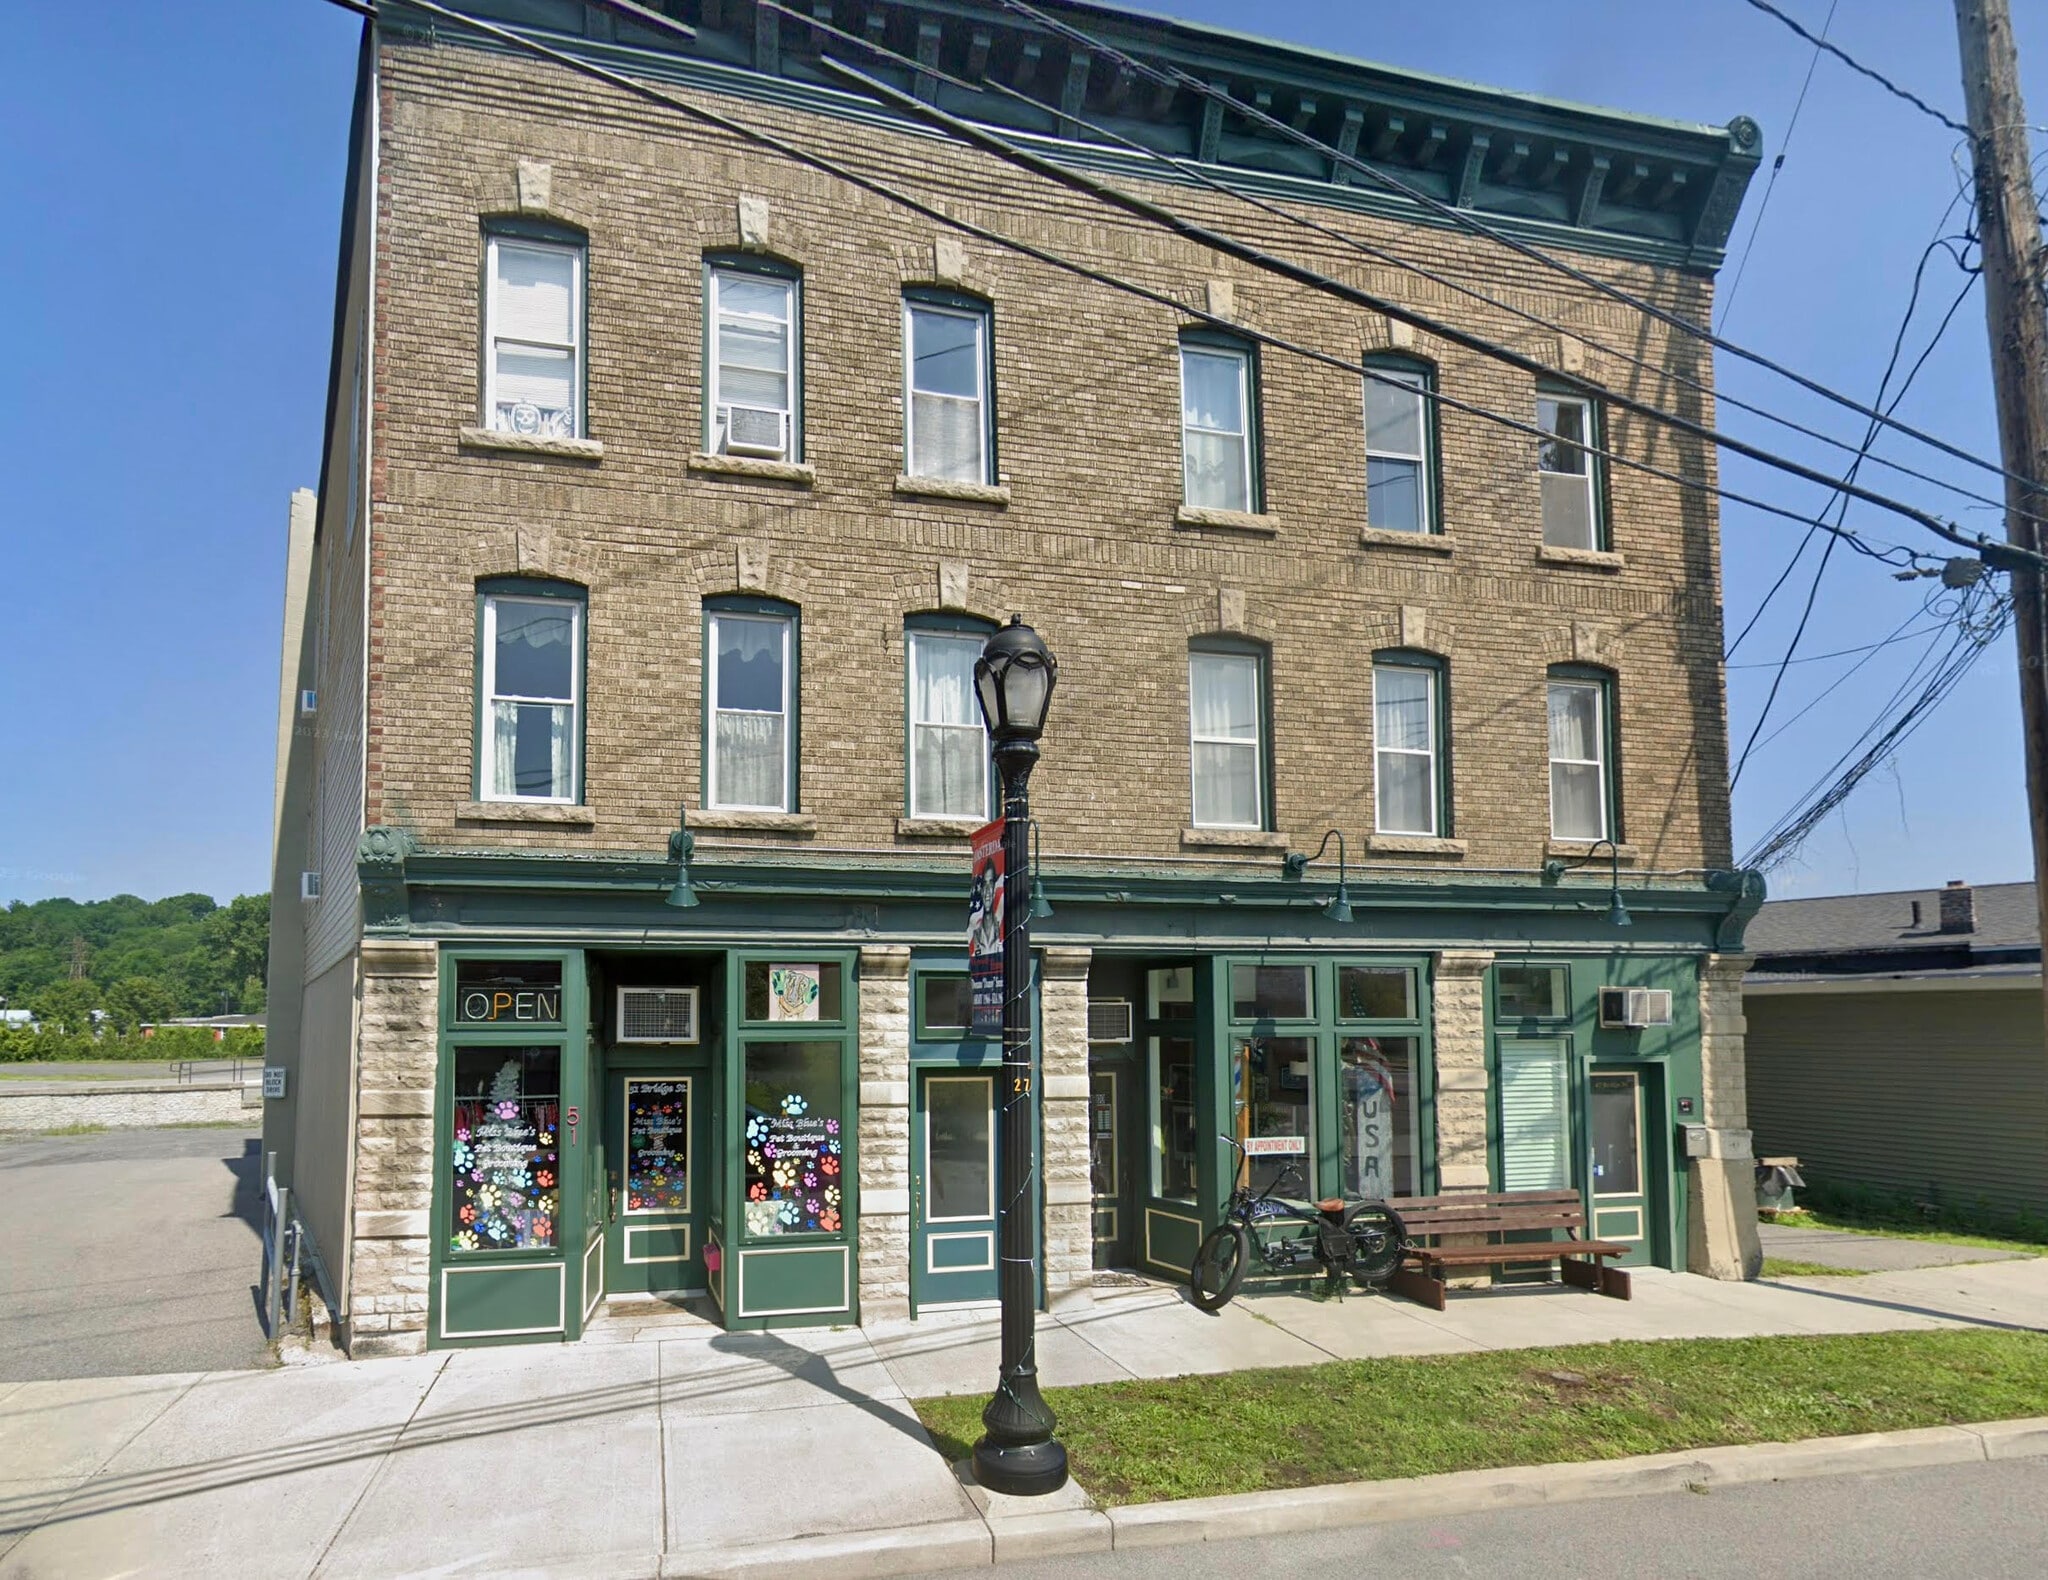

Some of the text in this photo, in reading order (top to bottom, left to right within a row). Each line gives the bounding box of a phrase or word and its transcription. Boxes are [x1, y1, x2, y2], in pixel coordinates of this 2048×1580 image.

[465, 993, 557, 1020] OPEN
[640, 1083, 674, 1096] Bridge
[1014, 1078, 1030, 1091] 27
[770, 1117, 824, 1129] Miss Blue's
[475, 1125, 536, 1137] Miss Blue's
[769, 1133, 825, 1144] Pet Boutique
[1363, 1101, 1379, 1178] USA
[474, 1142, 537, 1154] Pet Boutique
[1247, 1139, 1302, 1152] BY APPOINTMENT ONLY
[777, 1147, 818, 1158] Grooming
[483, 1158, 528, 1169] Grooming
